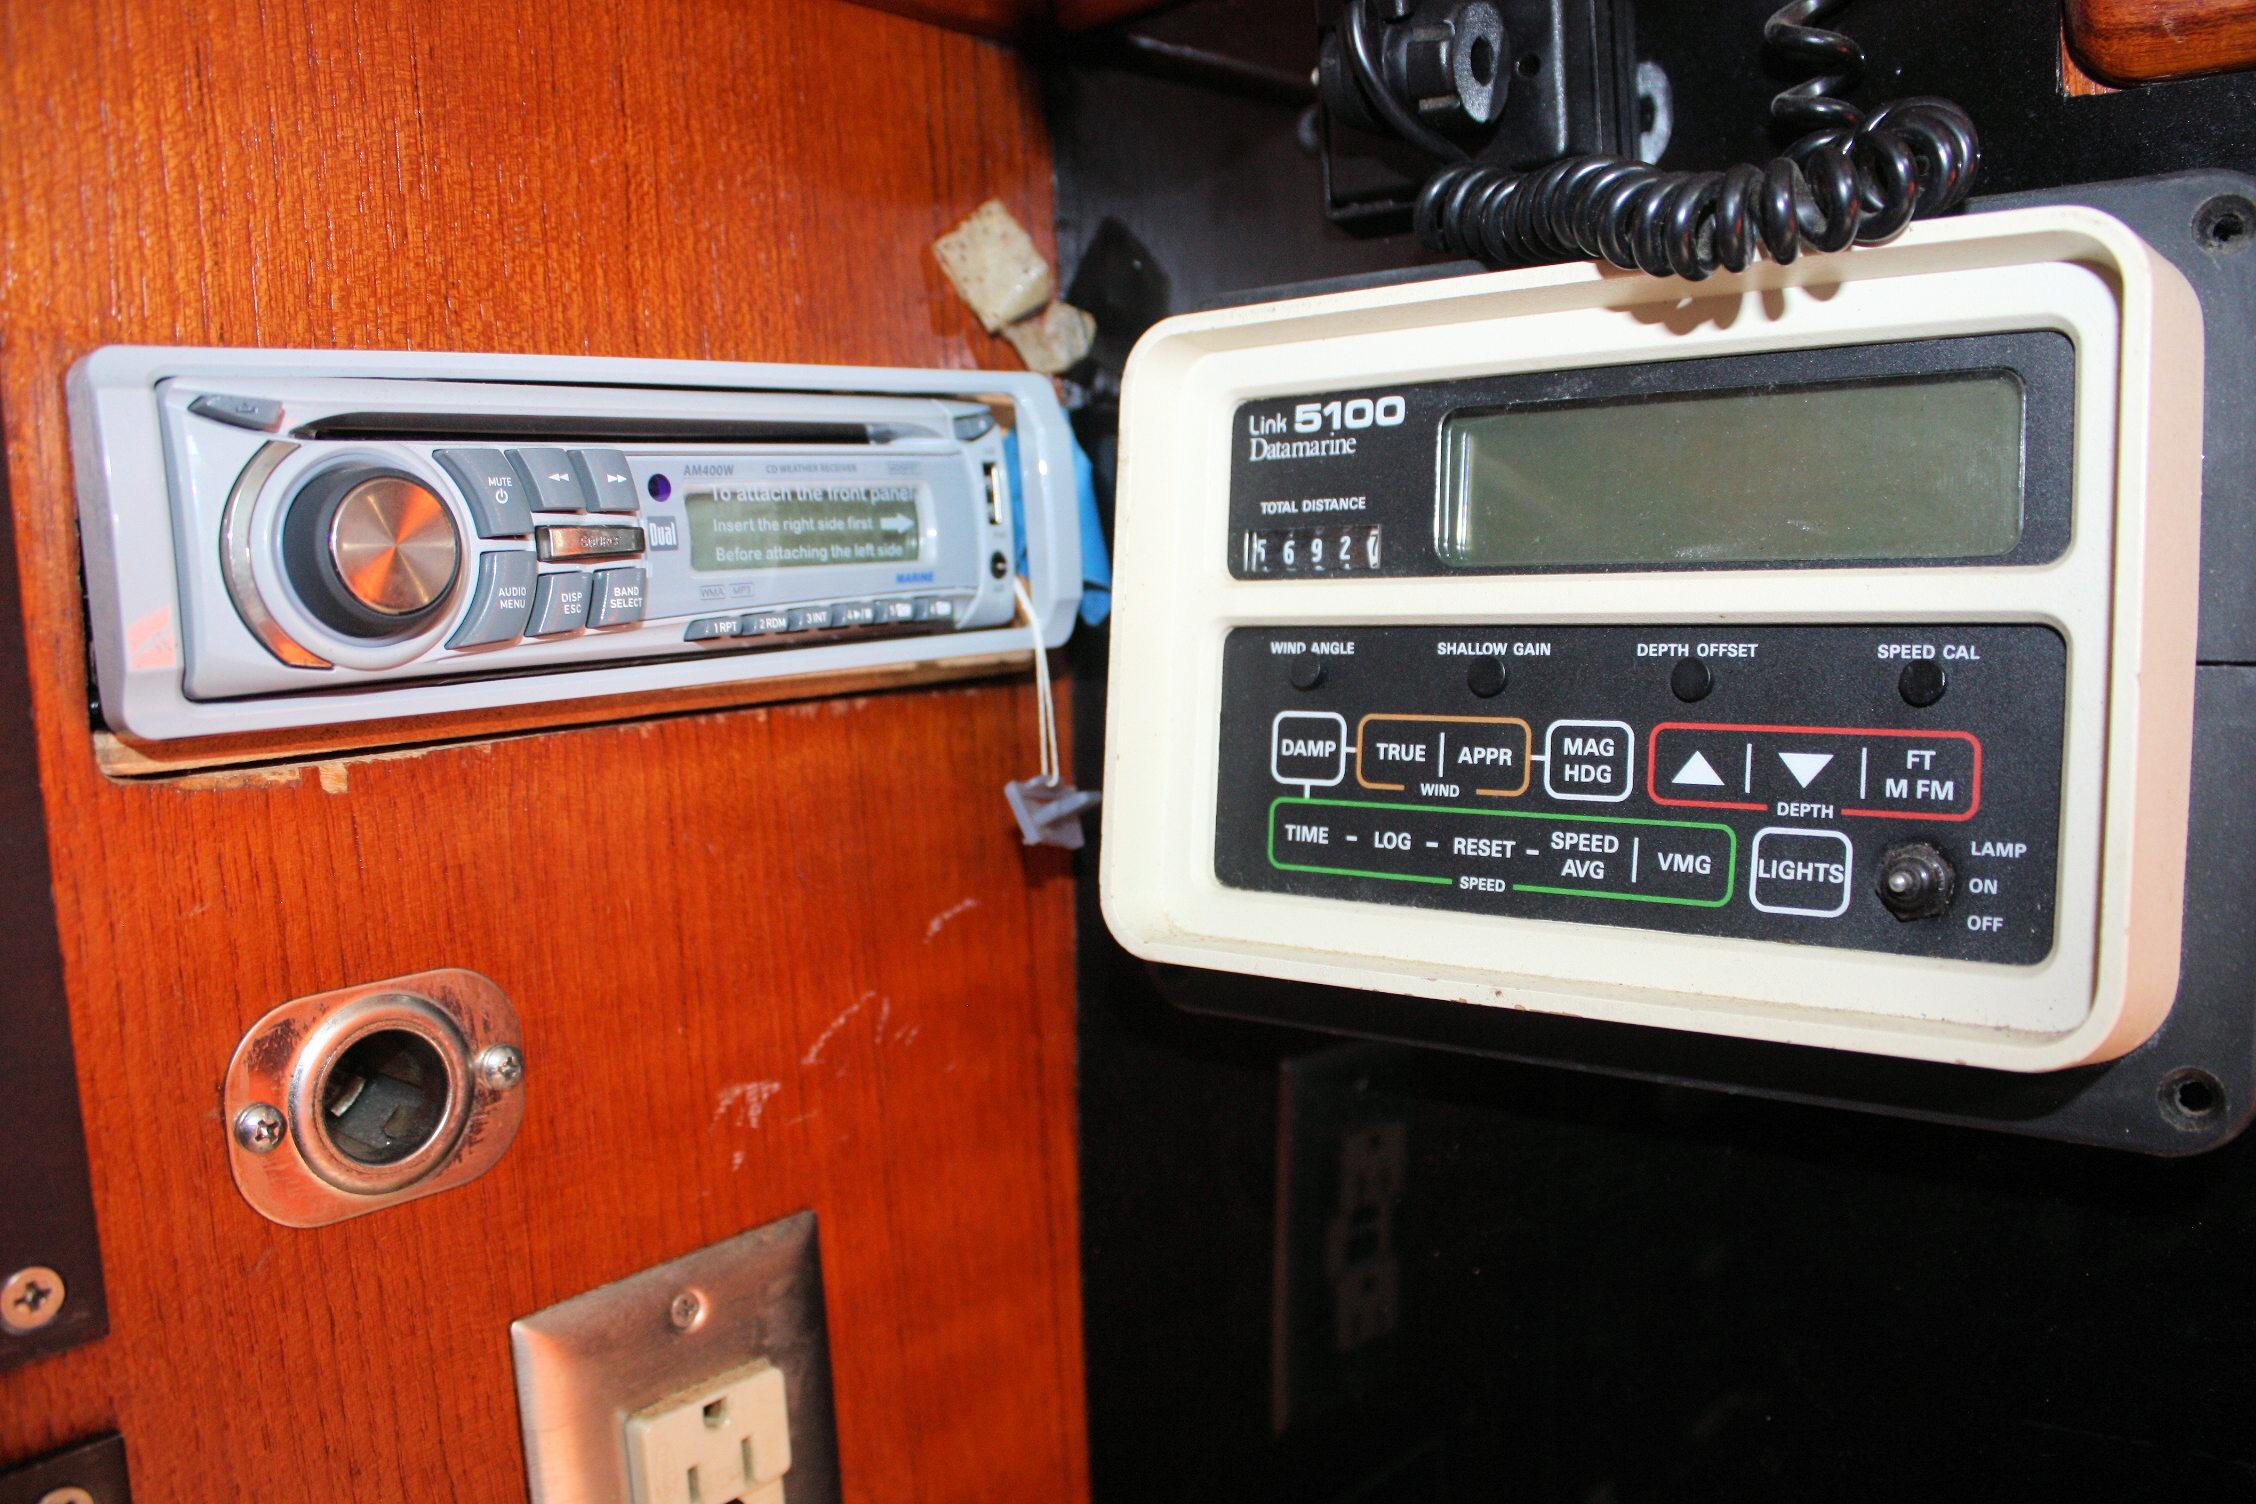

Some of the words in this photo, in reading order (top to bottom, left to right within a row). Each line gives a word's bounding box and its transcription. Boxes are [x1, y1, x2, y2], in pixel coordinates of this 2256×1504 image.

[1249, 413, 1287, 435] Link
[1293, 395, 1406, 433] 5100
[1249, 432, 1357, 462] Datamarine
[488, 477, 512, 488] MUTE
[737, 486, 791, 502] attach
[796, 485, 823, 502] the
[827, 485, 867, 502] front
[1260, 501, 1298, 515] TOTAL
[1302, 497, 1367, 513] DISTANCE
[713, 518, 755, 532] Insert
[757, 517, 780, 532] the
[783, 516, 814, 534] right
[818, 516, 846, 531] side
[847, 515, 874, 531] first
[649, 522, 677, 547] Dual
[716, 546, 762, 561] Before
[766, 545, 828, 561] attaching
[831, 544, 852, 559] the
[854, 543, 875, 557] left
[498, 587, 527, 597] AUDIO
[561, 593, 583, 603] DISP
[614, 586, 640, 597] BAND
[500, 599, 526, 609] MENU
[564, 604, 582, 614] ESC
[610, 598, 643, 608] SELECT
[1270, 642, 1307, 655] WIND
[1311, 642, 1355, 655] ANGLE
[1437, 642, 1508, 656] SHALLOW
[1513, 643, 1551, 656] GAIN
[1637, 643, 1690, 657] DEPTH
[1696, 643, 1758, 658] OFFSET
[1877, 644, 1936, 660] SPEED
[1943, 645, 1980, 660] CAL
[1281, 739, 1336, 757] DAMP
[1376, 743, 1426, 762] TRUE
[1563, 737, 1615, 757] MAG
[1457, 747, 1513, 766] APPR
[1906, 750, 1936, 770] FT
[1564, 764, 1613, 783] HDG
[1420, 783, 1460, 798] WIND
[1886, 778, 1908, 799] M
[1916, 780, 1954, 801] FM
[1777, 802, 1834, 819] DEPTH
[1285, 824, 1329, 845] TIME
[1374, 831, 1412, 850] LOG
[1453, 837, 1516, 858] RESET
[1550, 832, 1619, 853] SPEED
[1970, 841, 2027, 859] LAMP
[1561, 859, 1605, 880] AVG
[1657, 852, 1712, 875] VMG
[1757, 858, 1845, 885] LIGHTS
[1460, 876, 1506, 893] SPEED
[1968, 879, 1998, 895] ON
[1967, 916, 2004, 932] OFF
